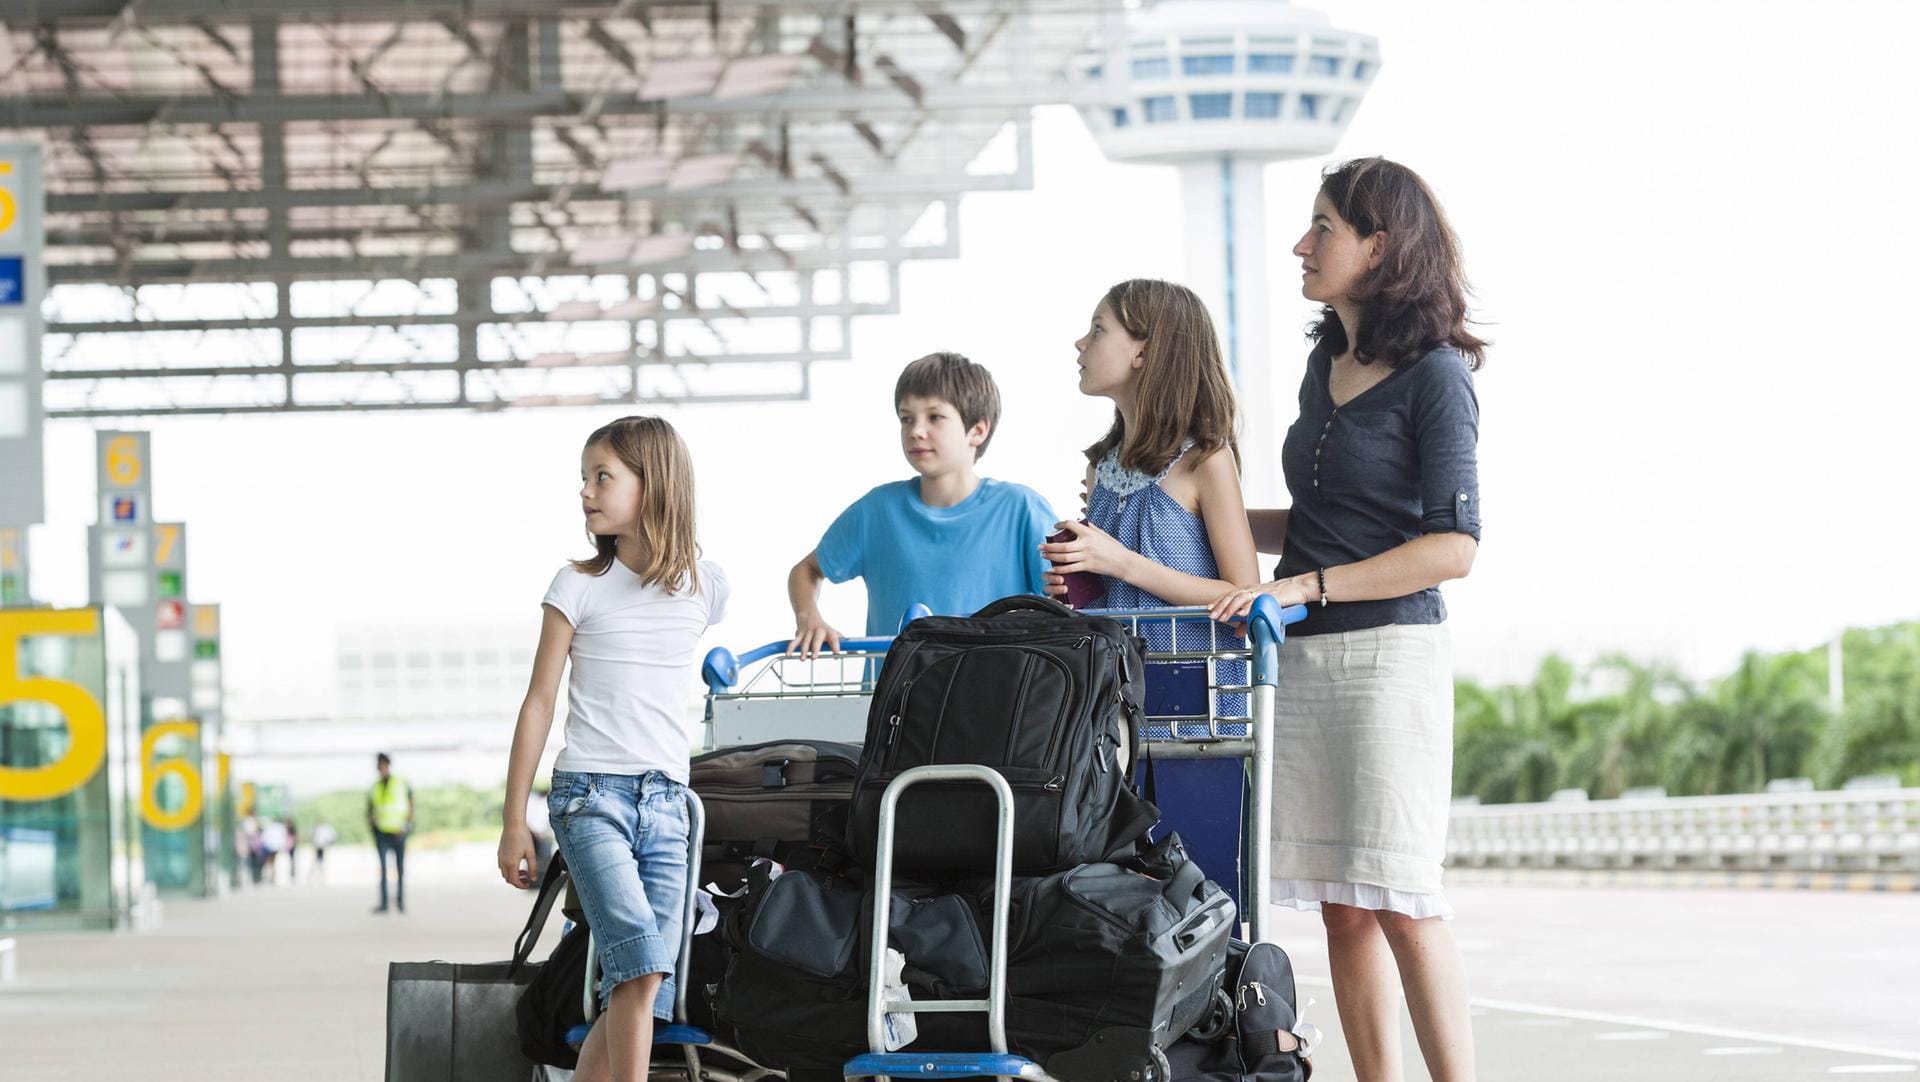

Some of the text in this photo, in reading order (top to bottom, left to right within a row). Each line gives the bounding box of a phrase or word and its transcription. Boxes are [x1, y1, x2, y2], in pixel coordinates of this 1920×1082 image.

[105, 435, 142, 486] 6
[154, 526, 179, 565] 7
[0, 606, 108, 801] 5
[138, 719, 205, 830] 6
